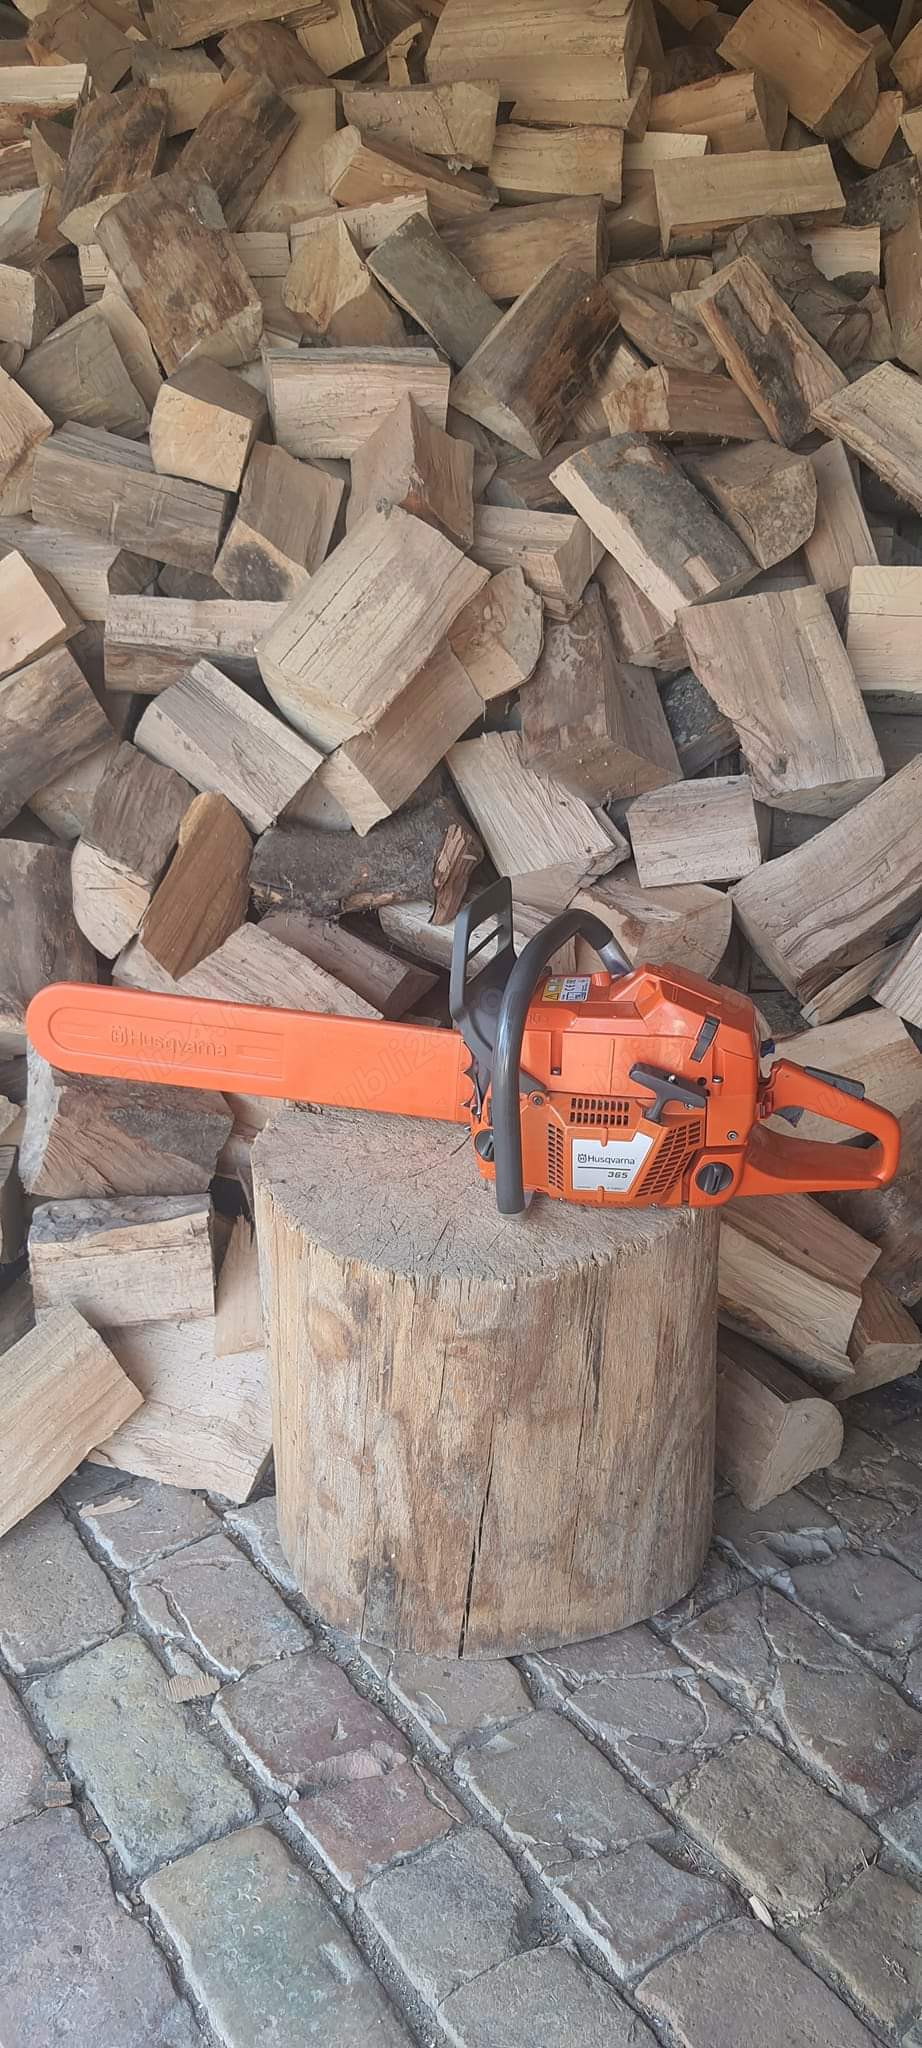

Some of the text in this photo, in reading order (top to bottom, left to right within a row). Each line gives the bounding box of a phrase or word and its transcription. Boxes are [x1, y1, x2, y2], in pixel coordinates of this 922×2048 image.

[131, 1030, 227, 1057] Husqvarna
[587, 1153, 635, 1165] Husqvarna
[607, 1171, 628, 1179] 365
